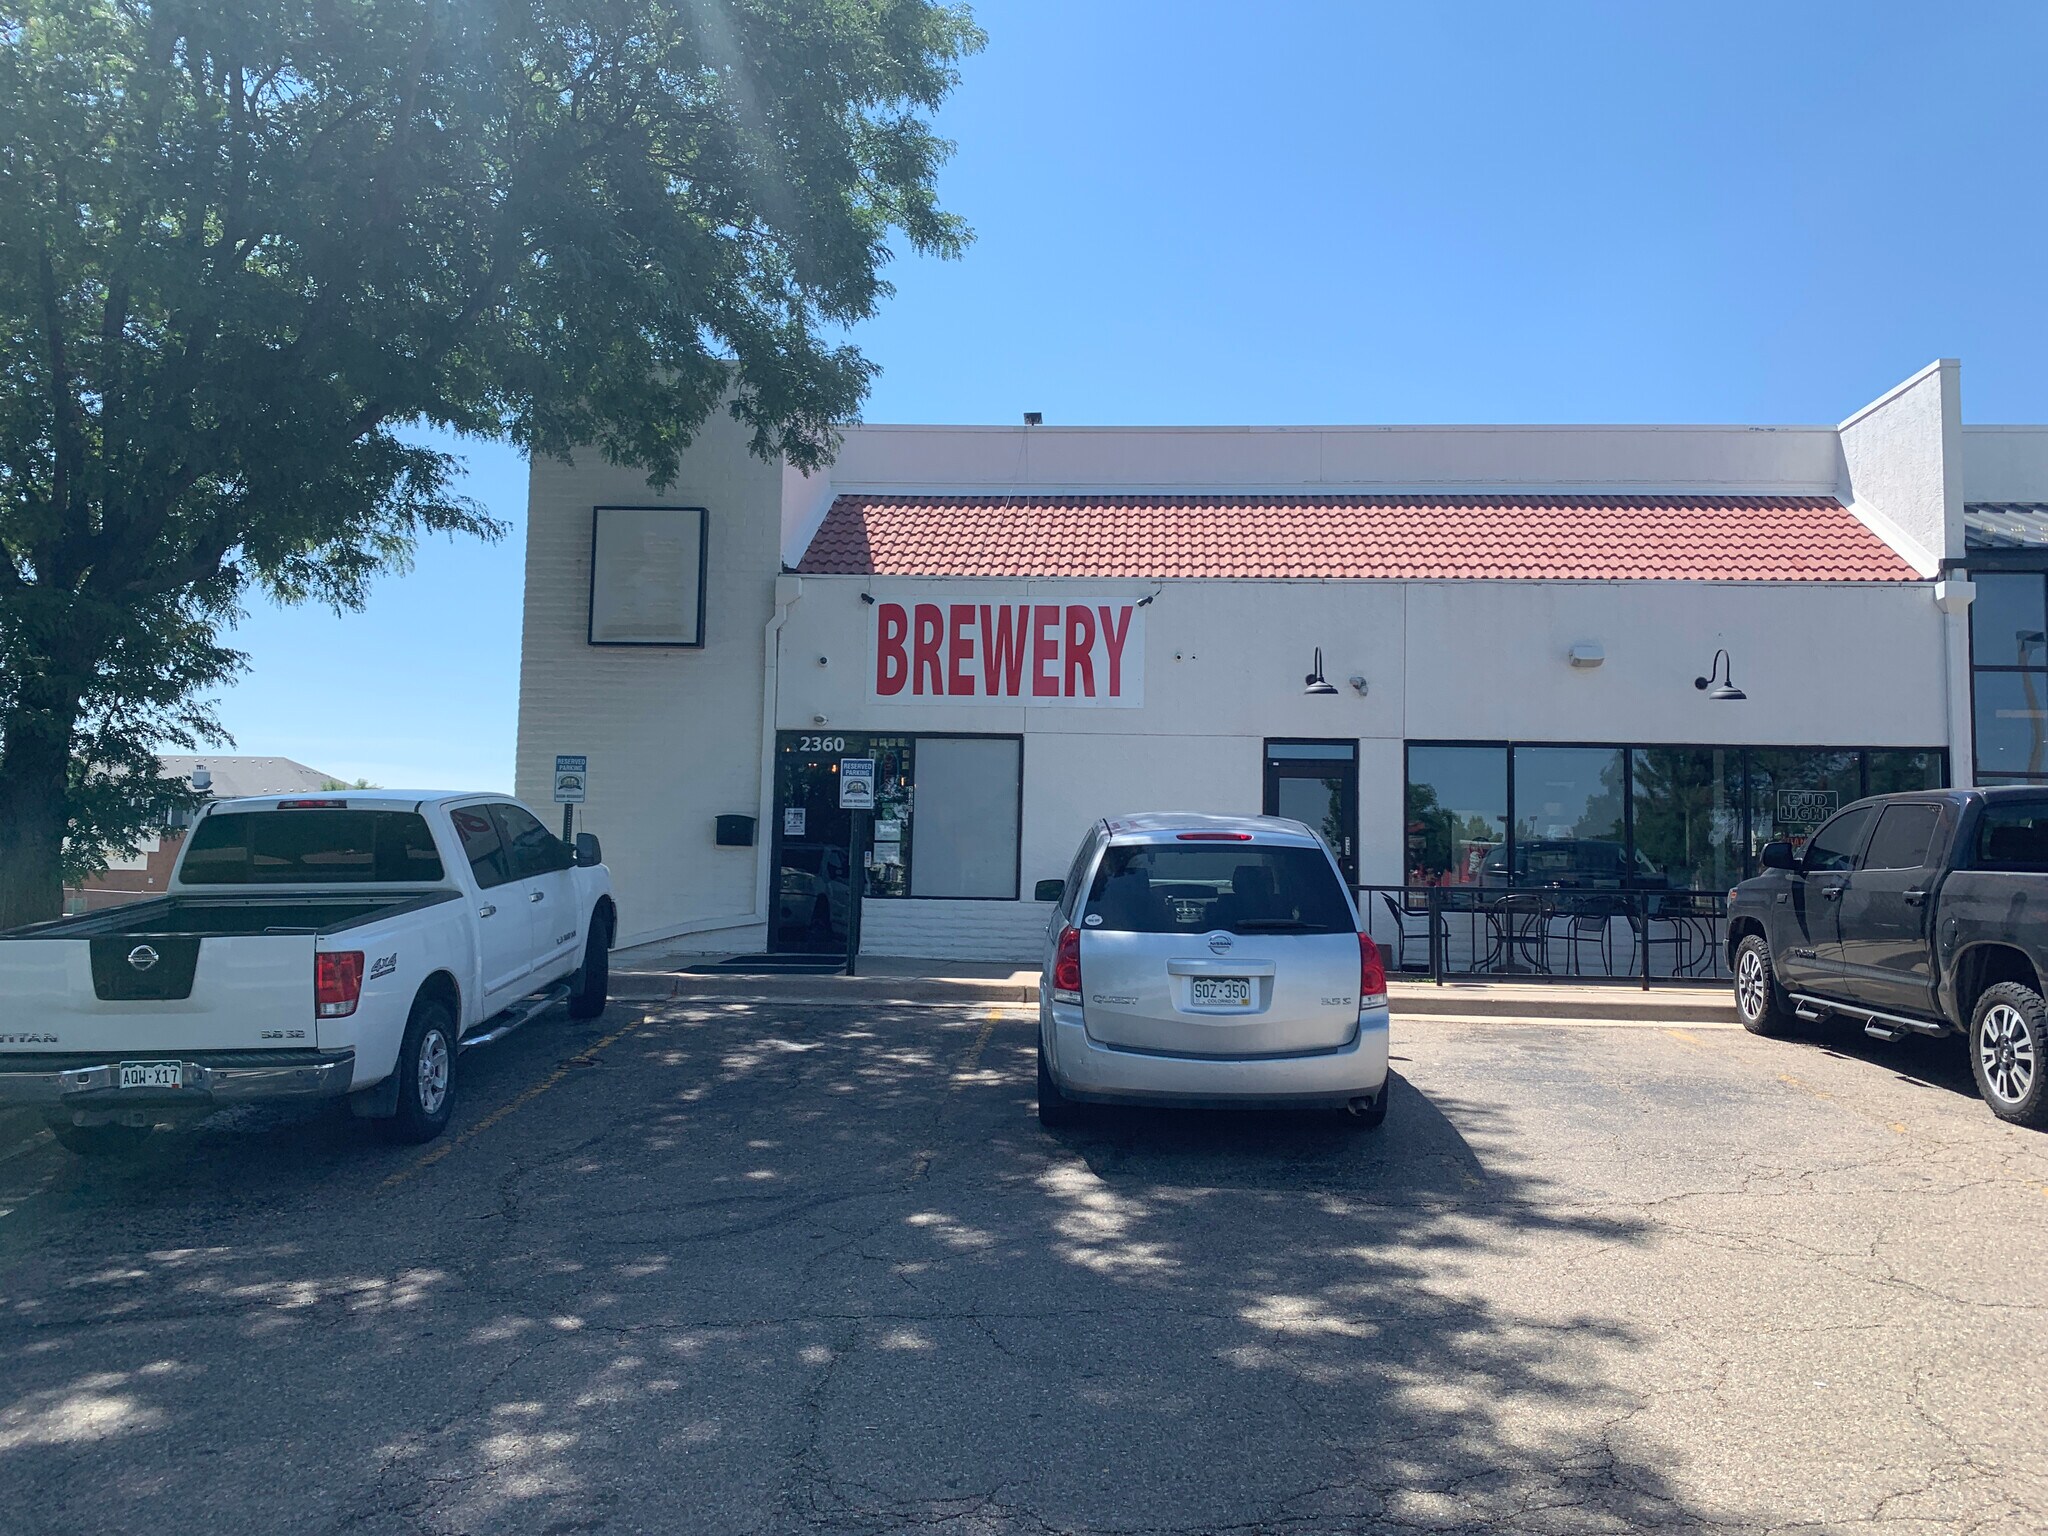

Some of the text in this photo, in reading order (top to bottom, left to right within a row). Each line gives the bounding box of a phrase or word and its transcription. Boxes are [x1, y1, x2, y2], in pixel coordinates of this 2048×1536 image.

[876, 603, 1134, 697] BREWERY
[800, 737, 845, 752] 2360
[1787, 793, 1828, 807] BUD
[1780, 806, 1836, 820] LIGHT
[1092, 995, 1139, 1005] QUEST
